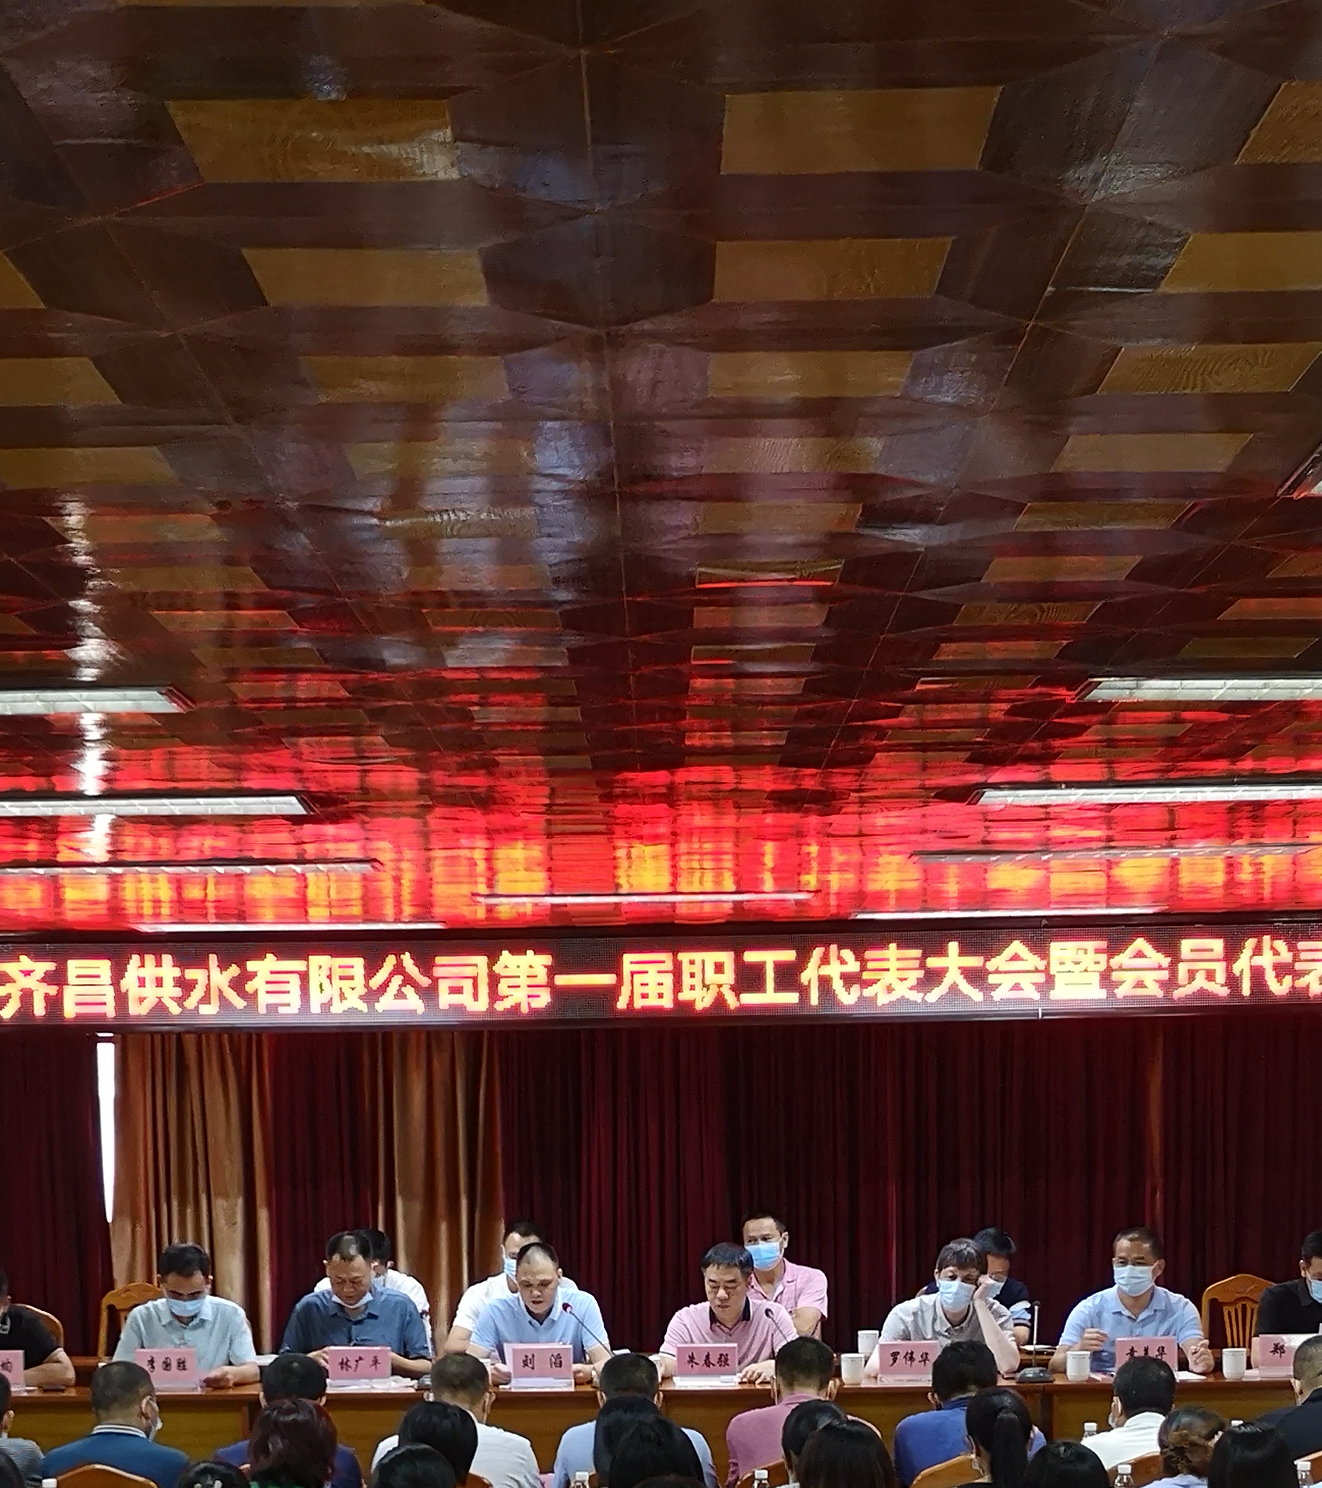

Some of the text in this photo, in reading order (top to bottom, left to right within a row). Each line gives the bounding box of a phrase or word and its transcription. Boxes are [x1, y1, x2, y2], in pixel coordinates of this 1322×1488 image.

[686, 1352, 730, 1369] 朱春强
[889, 1350, 930, 1368] 罗伟华
